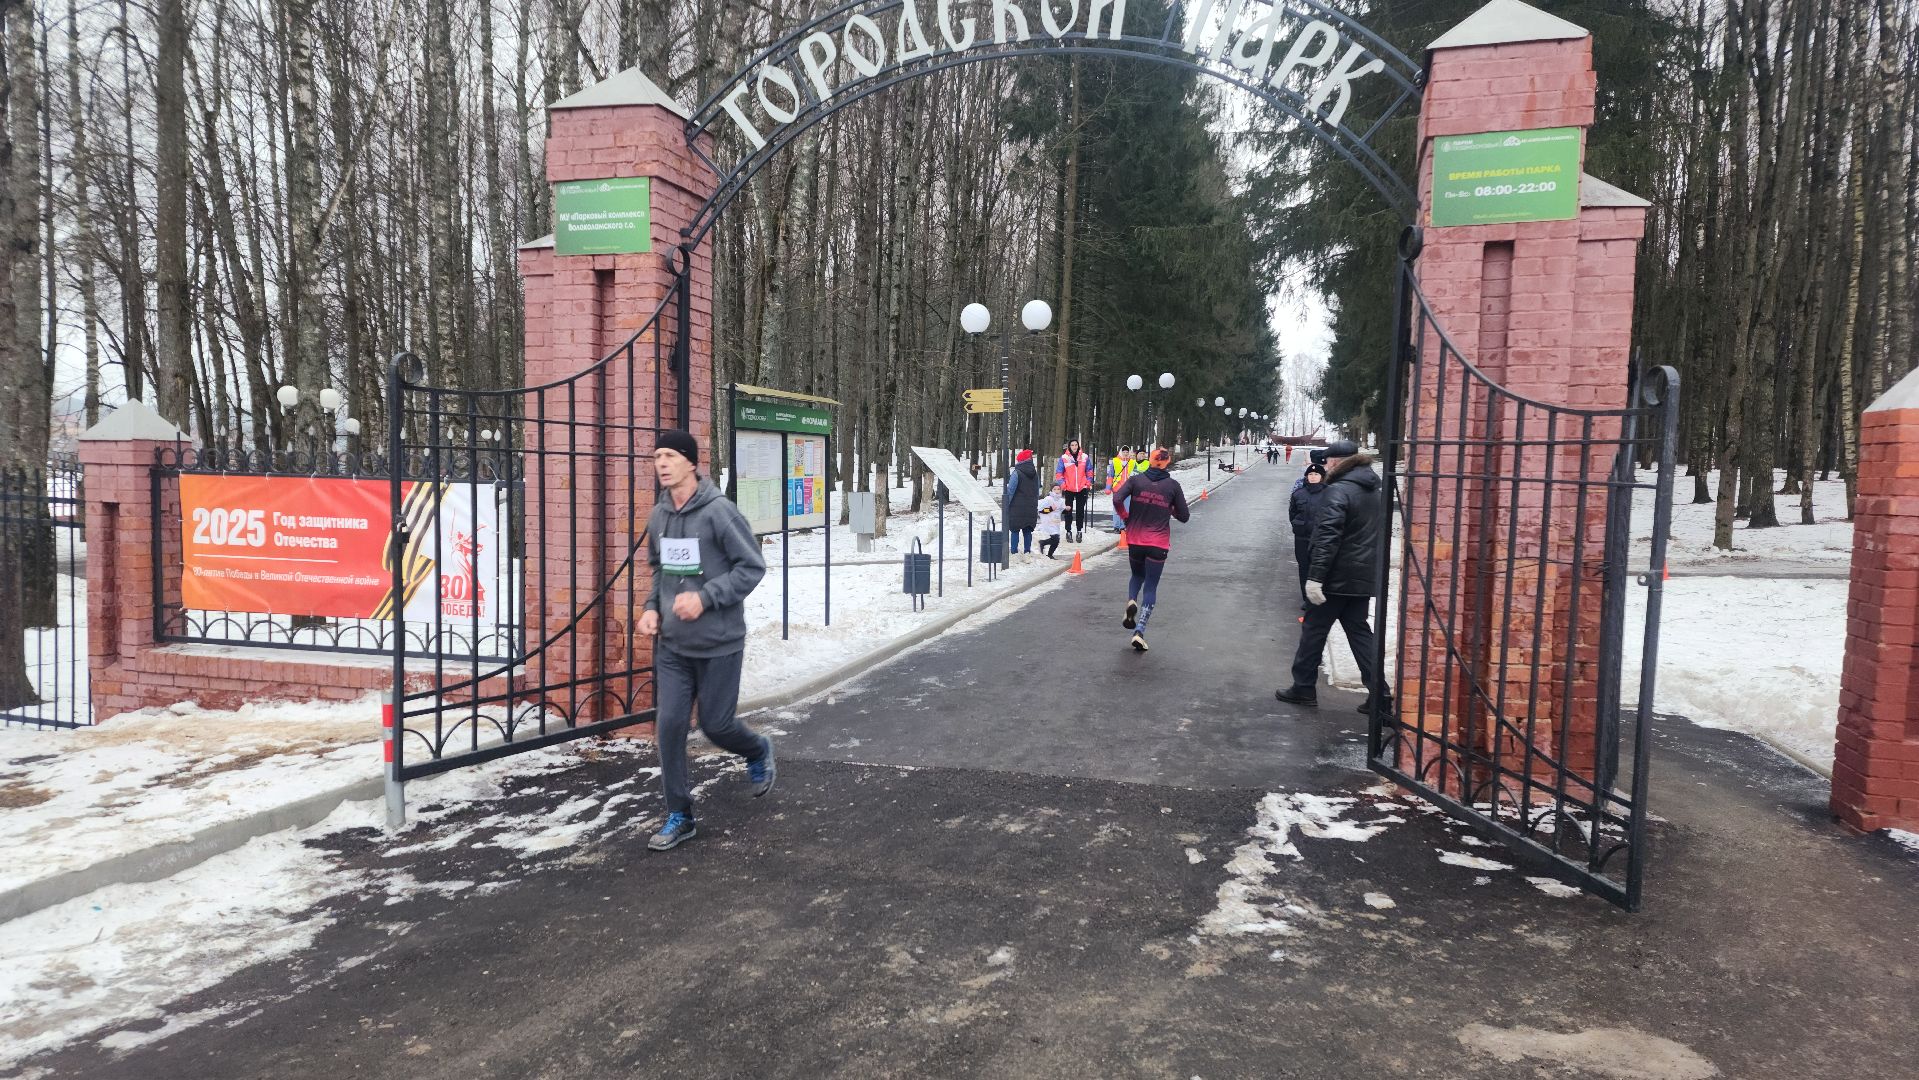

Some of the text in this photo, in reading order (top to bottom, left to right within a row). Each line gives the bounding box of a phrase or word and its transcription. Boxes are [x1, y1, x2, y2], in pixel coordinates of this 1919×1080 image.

[1449, 165, 1561, 180] ВРЕМЯ РАБОТЫ ПАРКА
[1475, 181, 1556, 197] 08:00-22:00
[560, 213, 570, 221] МУ
[568, 223, 623, 231] Волоколамского
[193, 507, 266, 547] 2025
[273, 511, 368, 530] Год защитника
[274, 531, 338, 549] Отечества
[225, 568, 253, 579] Победы
[260, 570, 293, 582] Великой
[295, 571, 354, 584] Отечественной
[355, 575, 380, 586] войне
